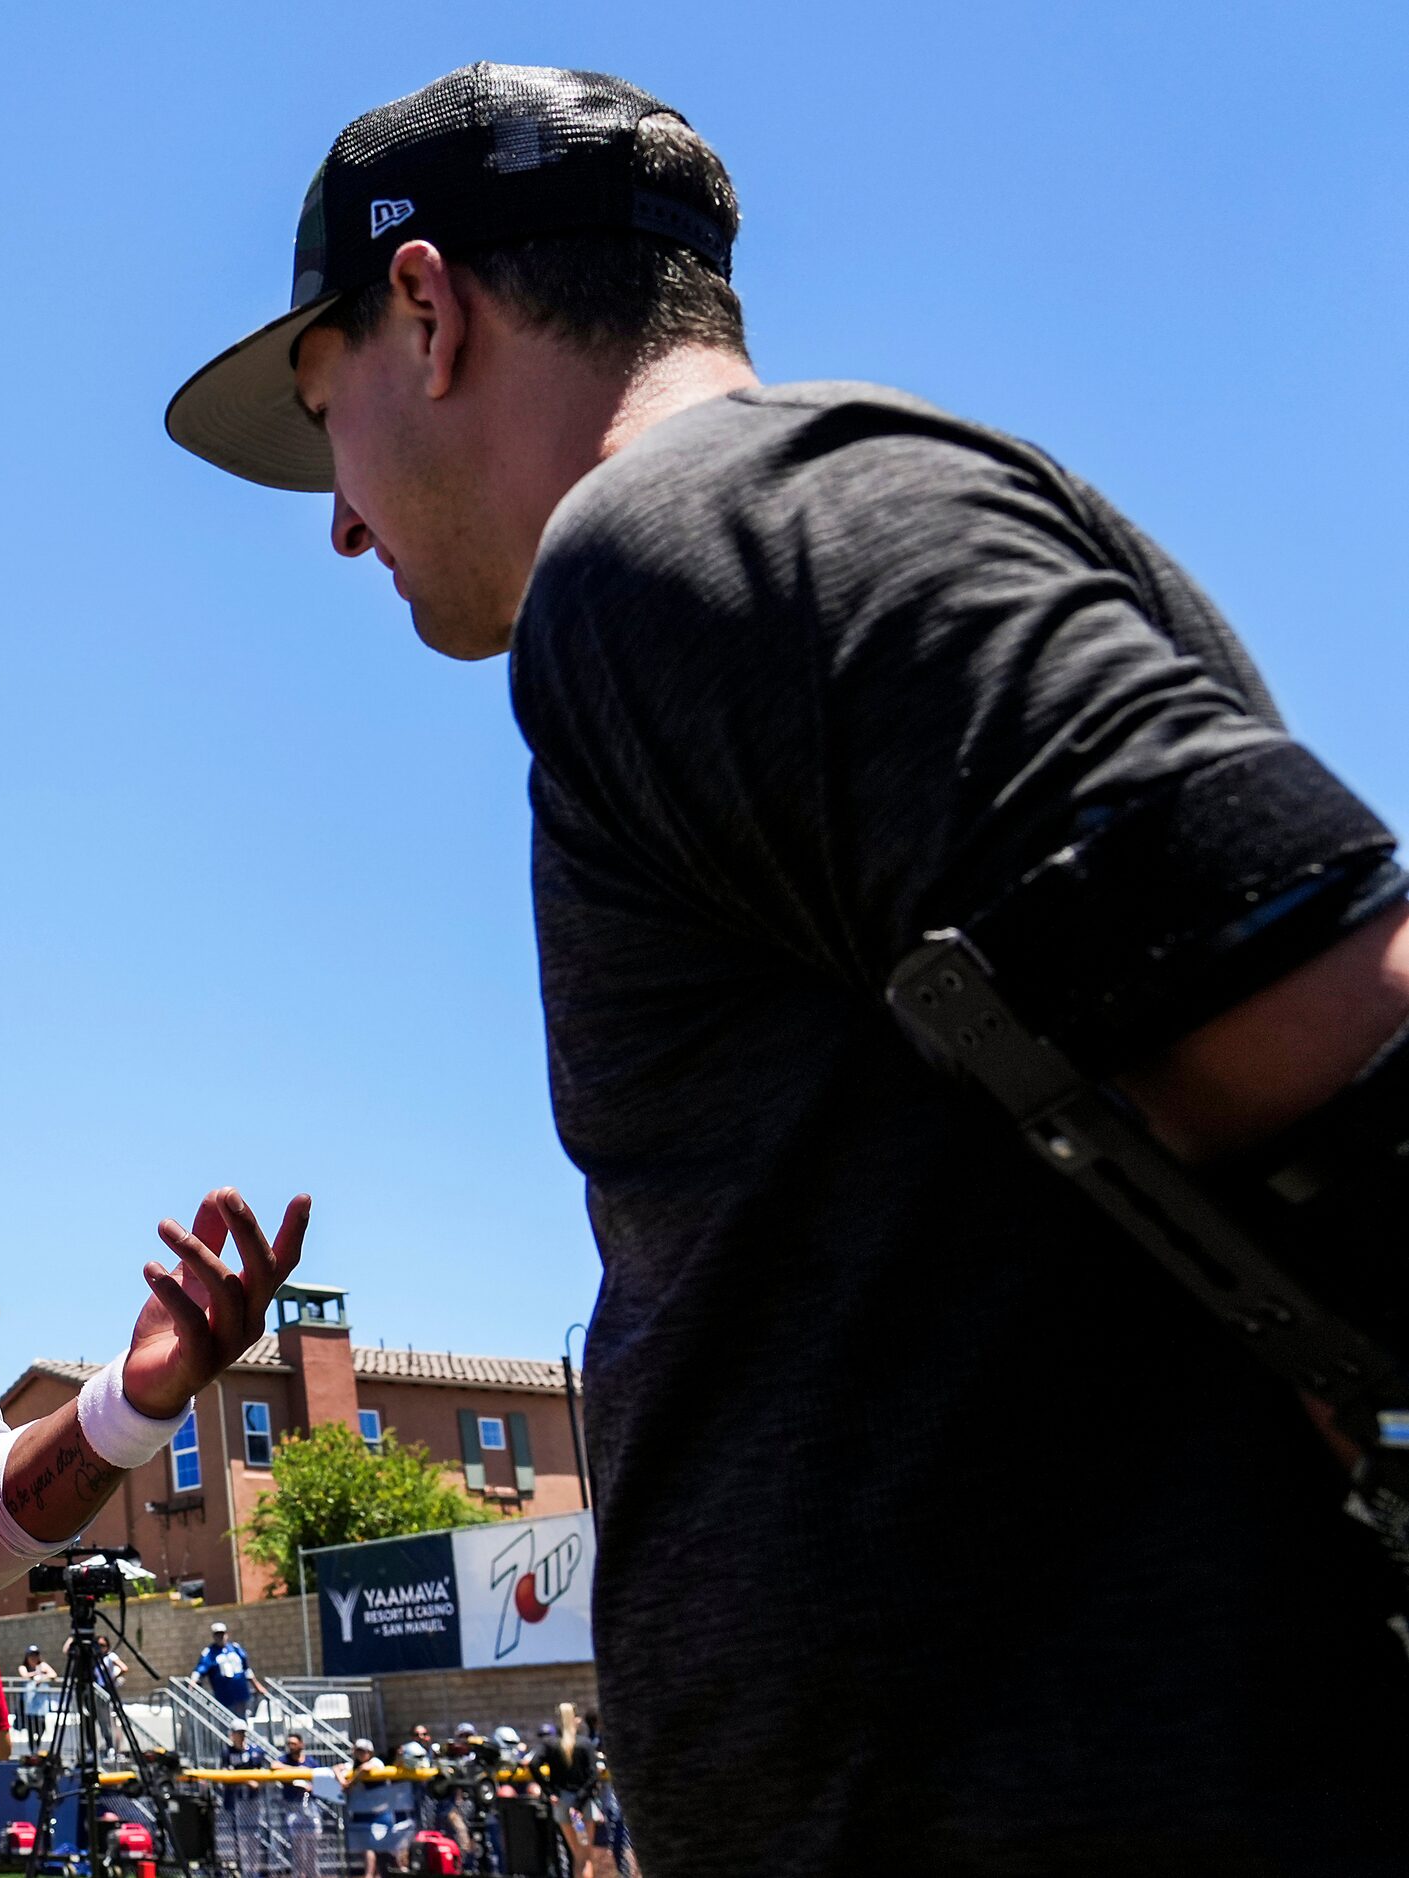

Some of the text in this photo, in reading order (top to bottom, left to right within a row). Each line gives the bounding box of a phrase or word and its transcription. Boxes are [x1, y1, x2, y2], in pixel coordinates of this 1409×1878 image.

[363, 1602, 455, 1624] RESORT & CASINO
[382, 1624, 404, 1638] SAN
[405, 1620, 447, 1636] MANUEL
